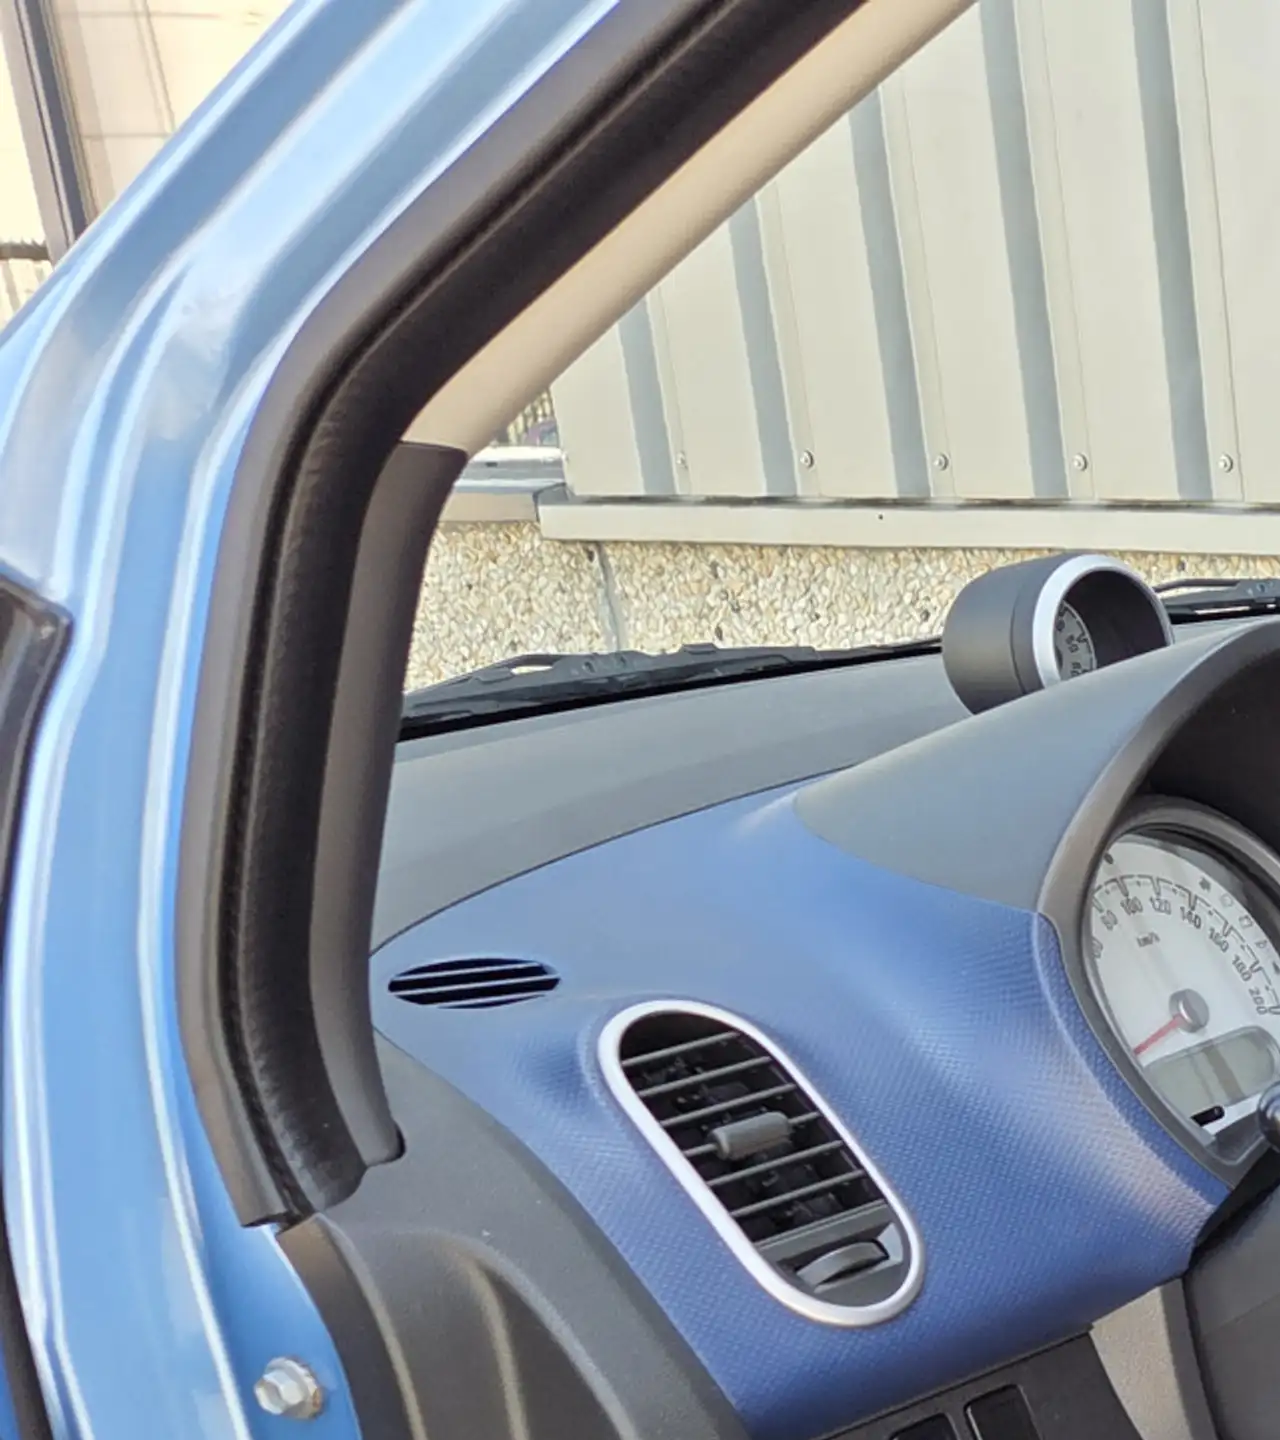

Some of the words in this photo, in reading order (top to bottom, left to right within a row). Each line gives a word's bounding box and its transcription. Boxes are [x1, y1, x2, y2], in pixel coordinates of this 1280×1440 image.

[1150, 896, 1172, 915] 120
[1180, 906, 1202, 929] 140
[1249, 986, 1268, 1015] 200
